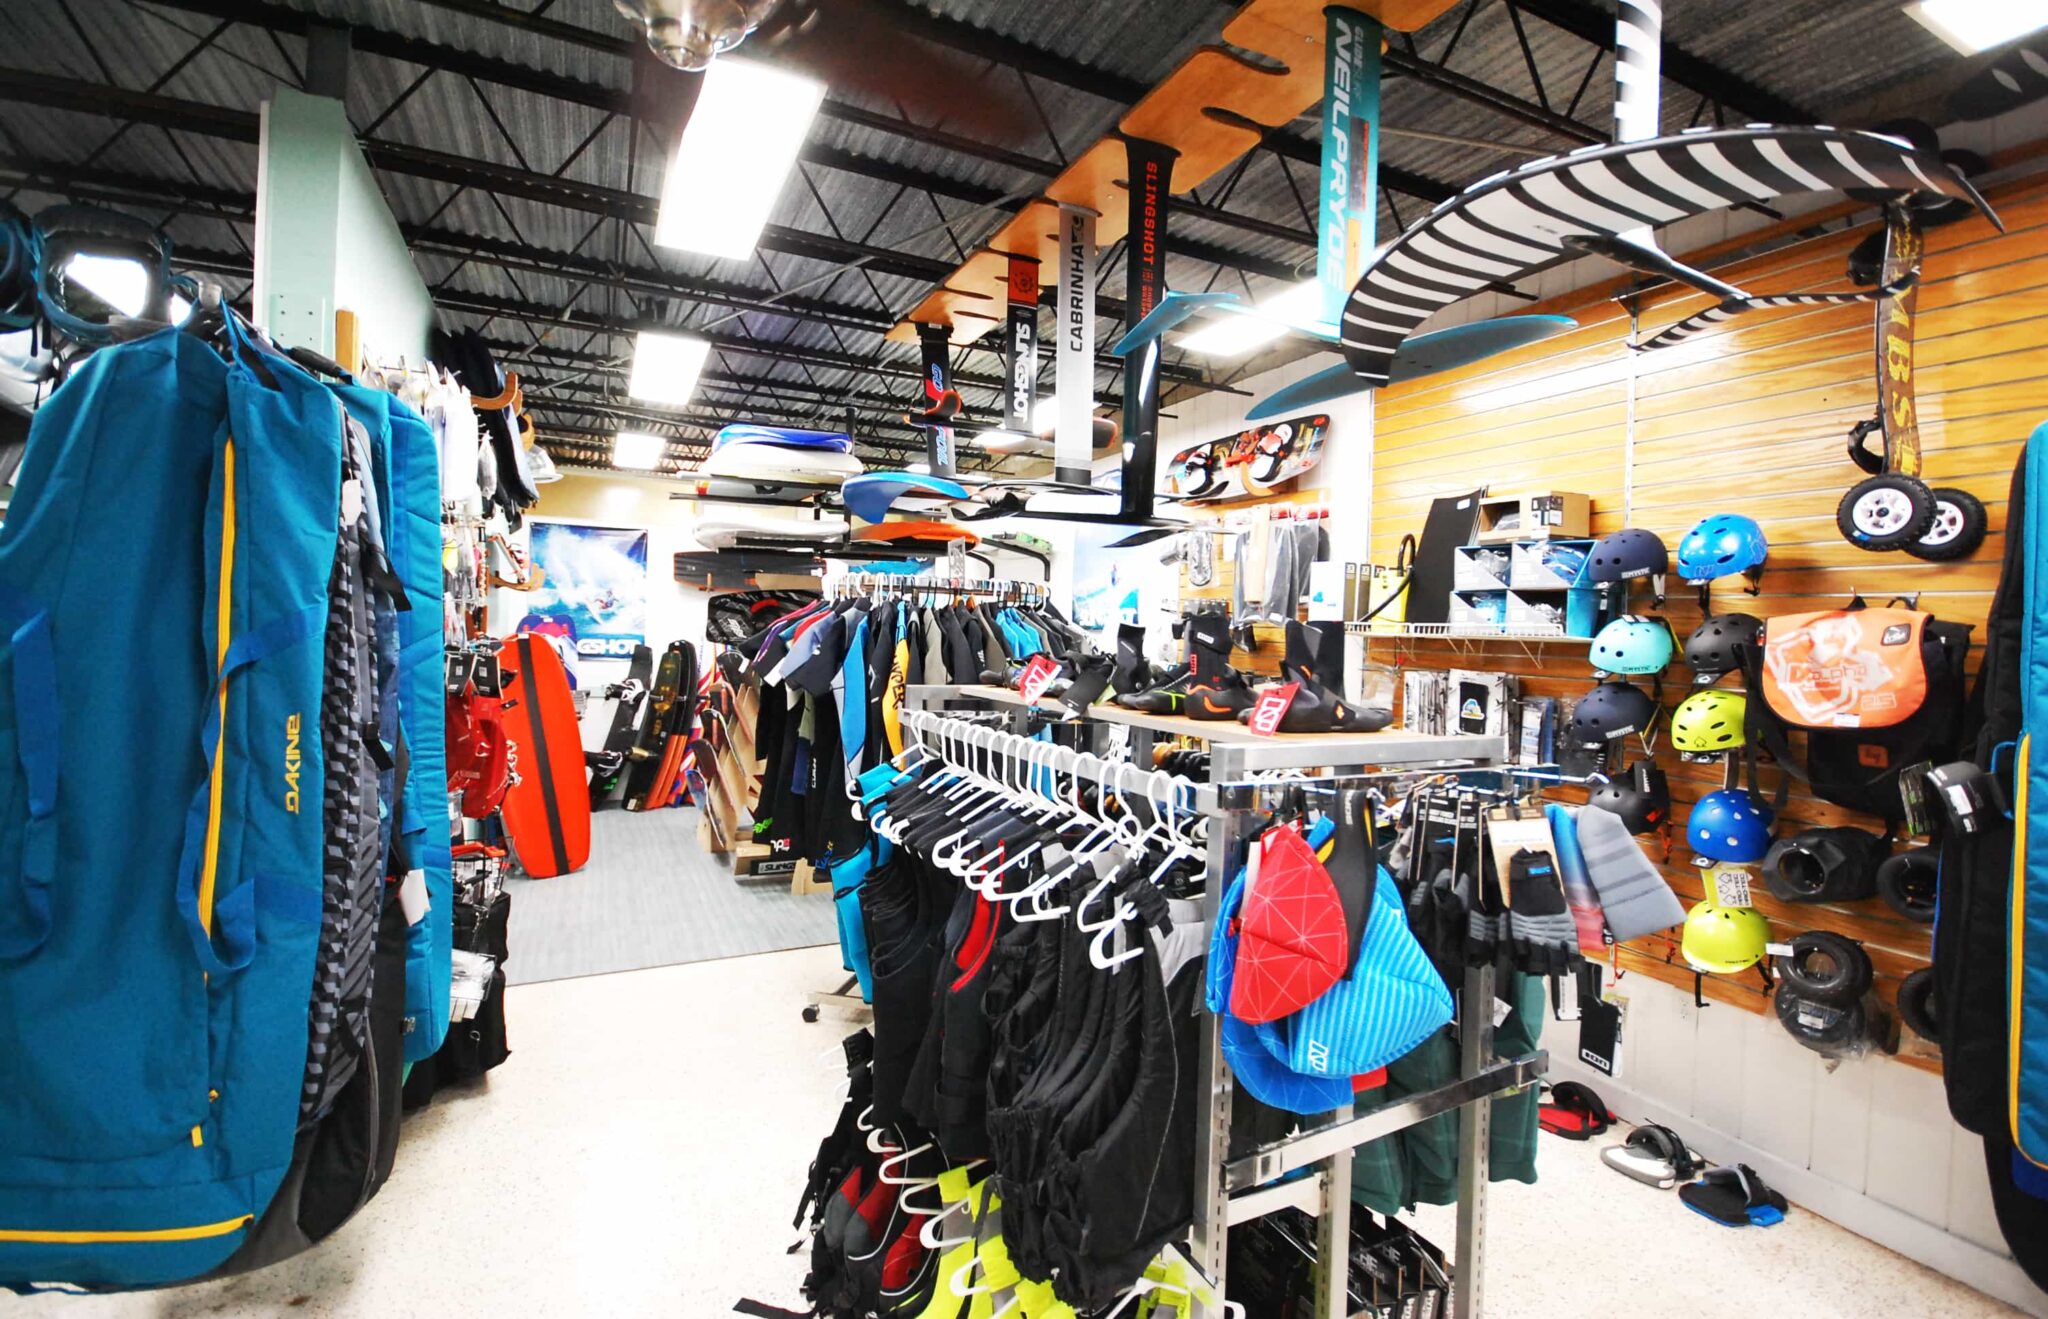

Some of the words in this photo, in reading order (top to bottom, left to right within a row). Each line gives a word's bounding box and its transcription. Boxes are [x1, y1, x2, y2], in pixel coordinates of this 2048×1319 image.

[1326, 17, 1352, 290] NEILPRYDE
[1142, 160, 1158, 266] SLINGSHOT
[1070, 244, 1084, 352] CABRINHA
[1012, 322, 1031, 424] SLINGSHOT
[576, 638, 641, 655] GSHOT
[285, 713, 301, 815] DAKINE
[764, 861, 795, 872] SLING
